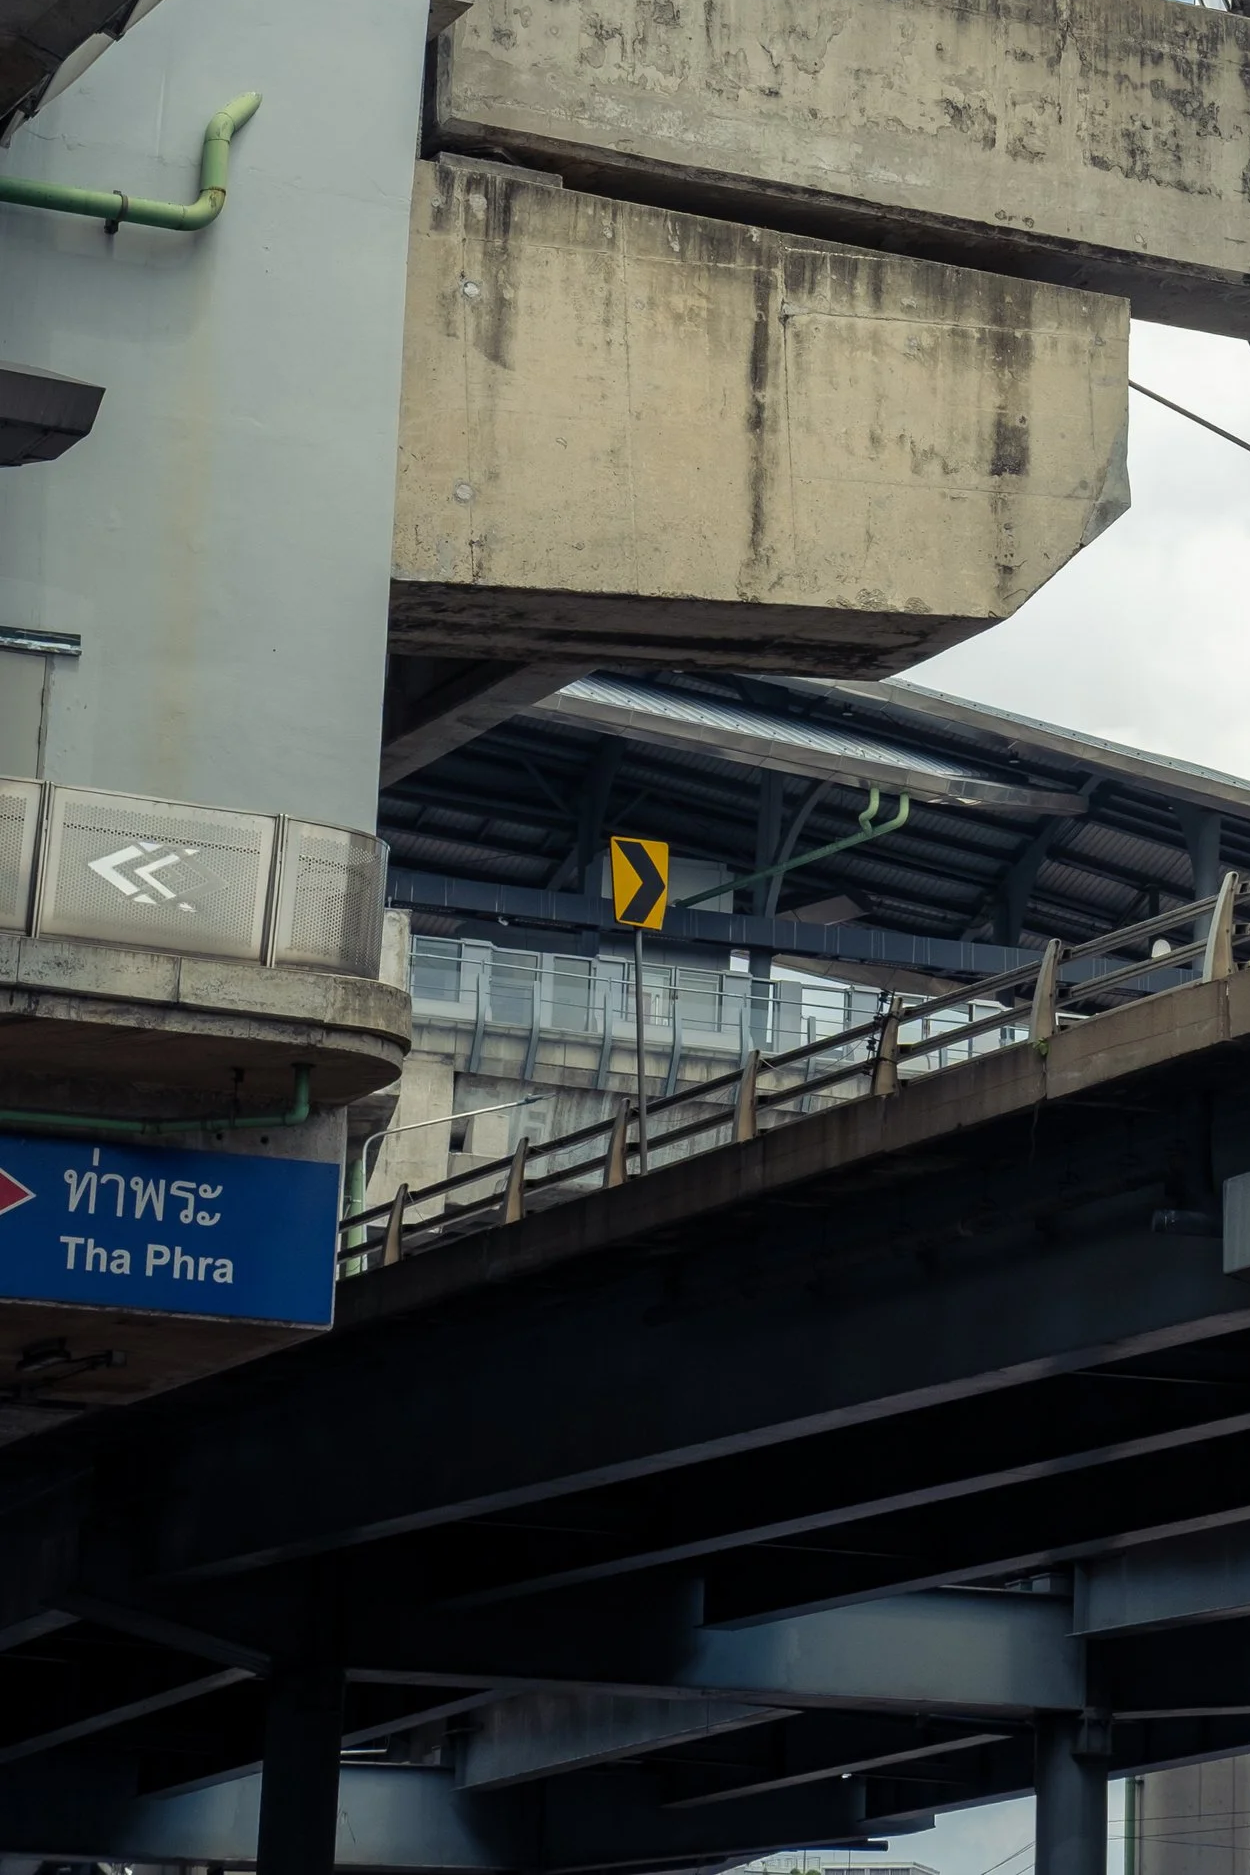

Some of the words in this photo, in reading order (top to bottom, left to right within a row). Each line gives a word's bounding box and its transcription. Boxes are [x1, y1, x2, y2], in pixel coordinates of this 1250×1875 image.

[63, 1147, 223, 1226] ท่าพระ
[60, 1235, 131, 1275] Tha
[145, 1243, 234, 1284] Phra
